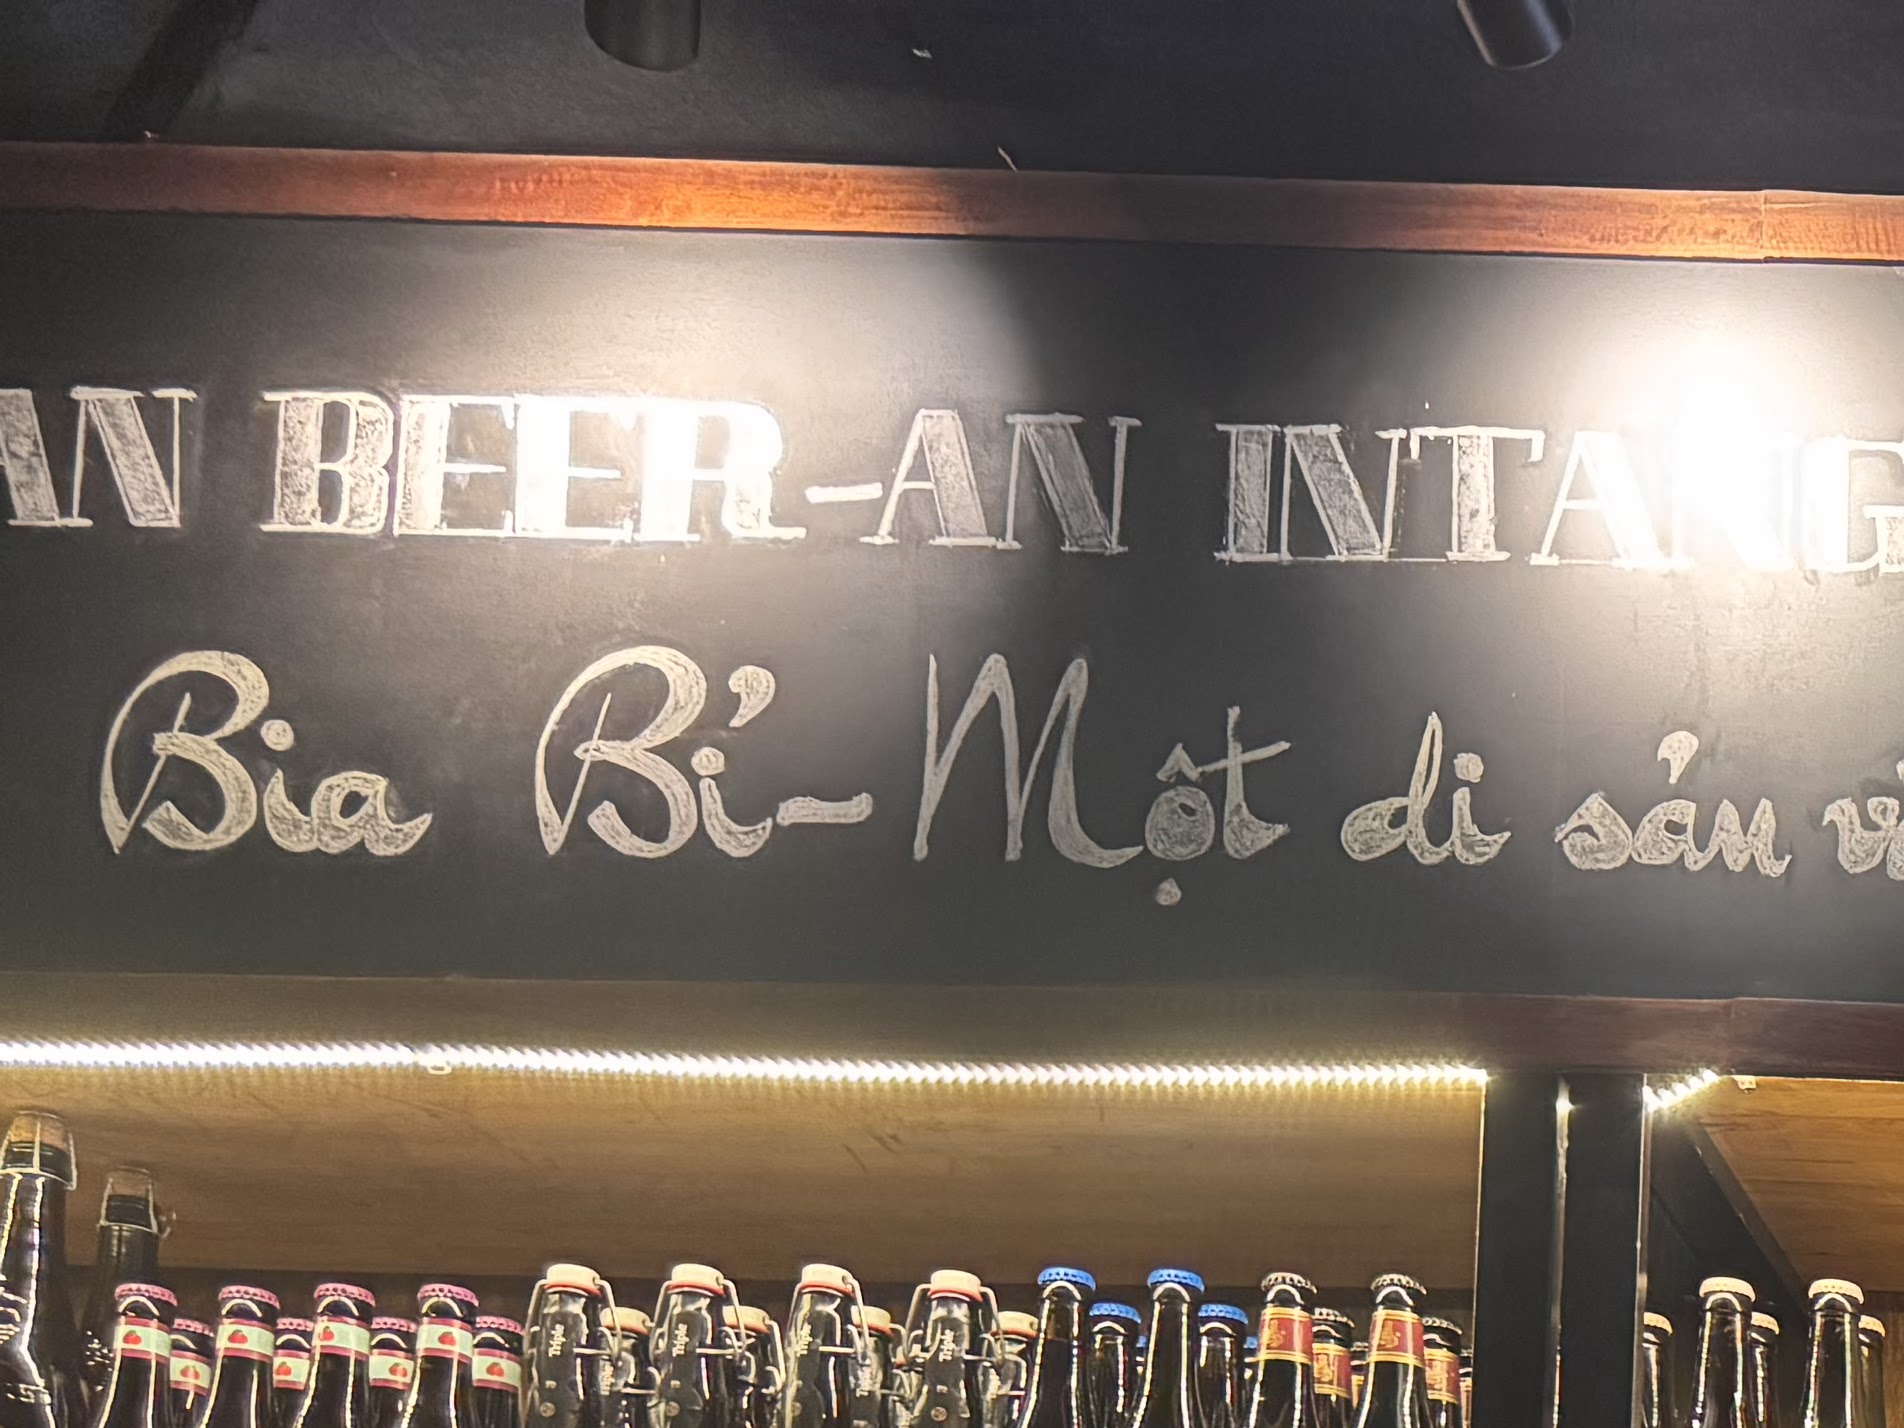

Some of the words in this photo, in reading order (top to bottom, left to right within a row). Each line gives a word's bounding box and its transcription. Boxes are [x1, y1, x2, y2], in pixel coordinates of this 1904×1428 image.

[101, 648, 433, 855] Bia
[913, 652, 1290, 906] Một
[1340, 710, 1510, 866] di
